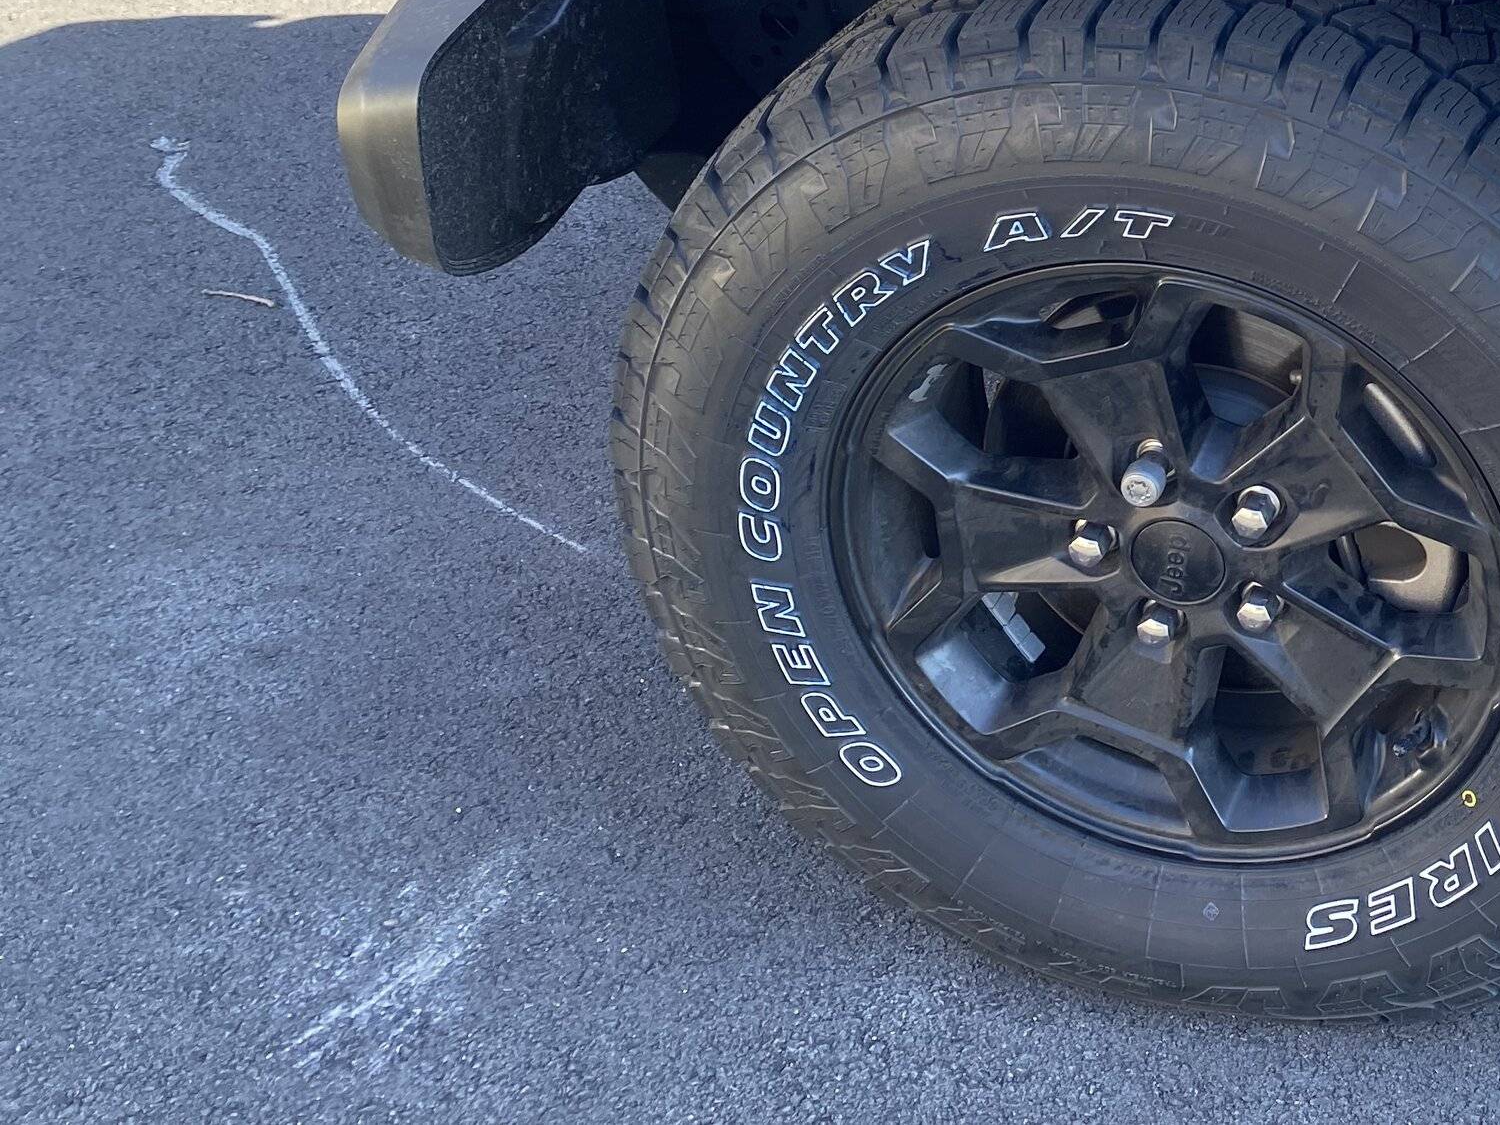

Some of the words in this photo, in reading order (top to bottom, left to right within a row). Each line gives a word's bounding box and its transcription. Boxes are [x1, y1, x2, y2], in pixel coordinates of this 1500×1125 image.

[983, 208, 1174, 252] A/T
[738, 239, 931, 563] COUNTRY
[1159, 534, 1192, 594] Jeep
[750, 581, 902, 788] OPEN
